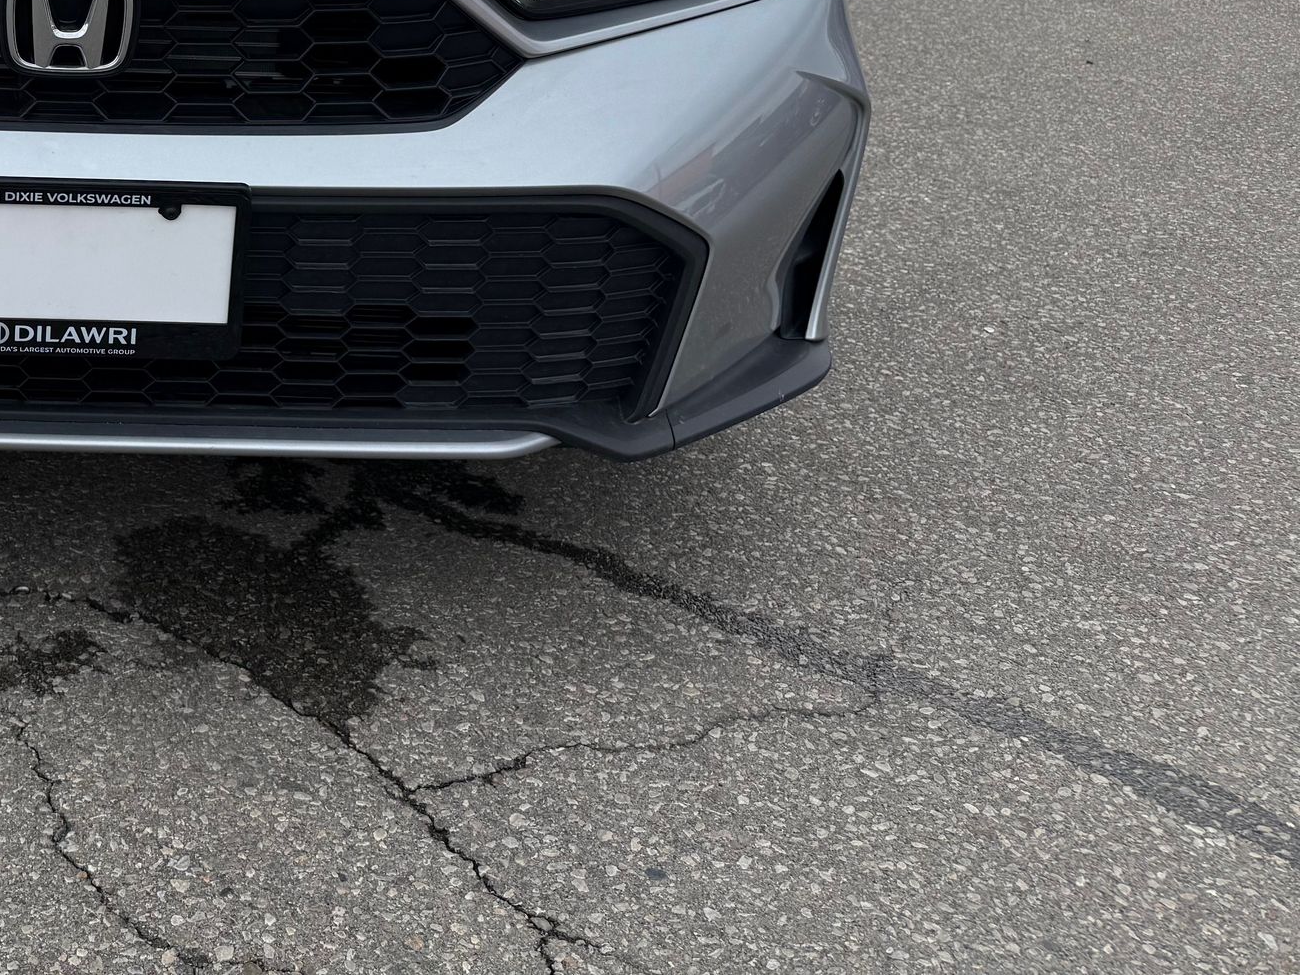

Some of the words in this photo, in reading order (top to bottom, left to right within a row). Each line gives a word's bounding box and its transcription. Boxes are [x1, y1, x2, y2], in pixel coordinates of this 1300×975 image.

[4, 191, 44, 202] DIXIE
[47, 192, 151, 205] VOLKSWAGEN
[14, 324, 137, 345] DILAWRI
[55, 347, 106, 355] AUTOMOTIVE
